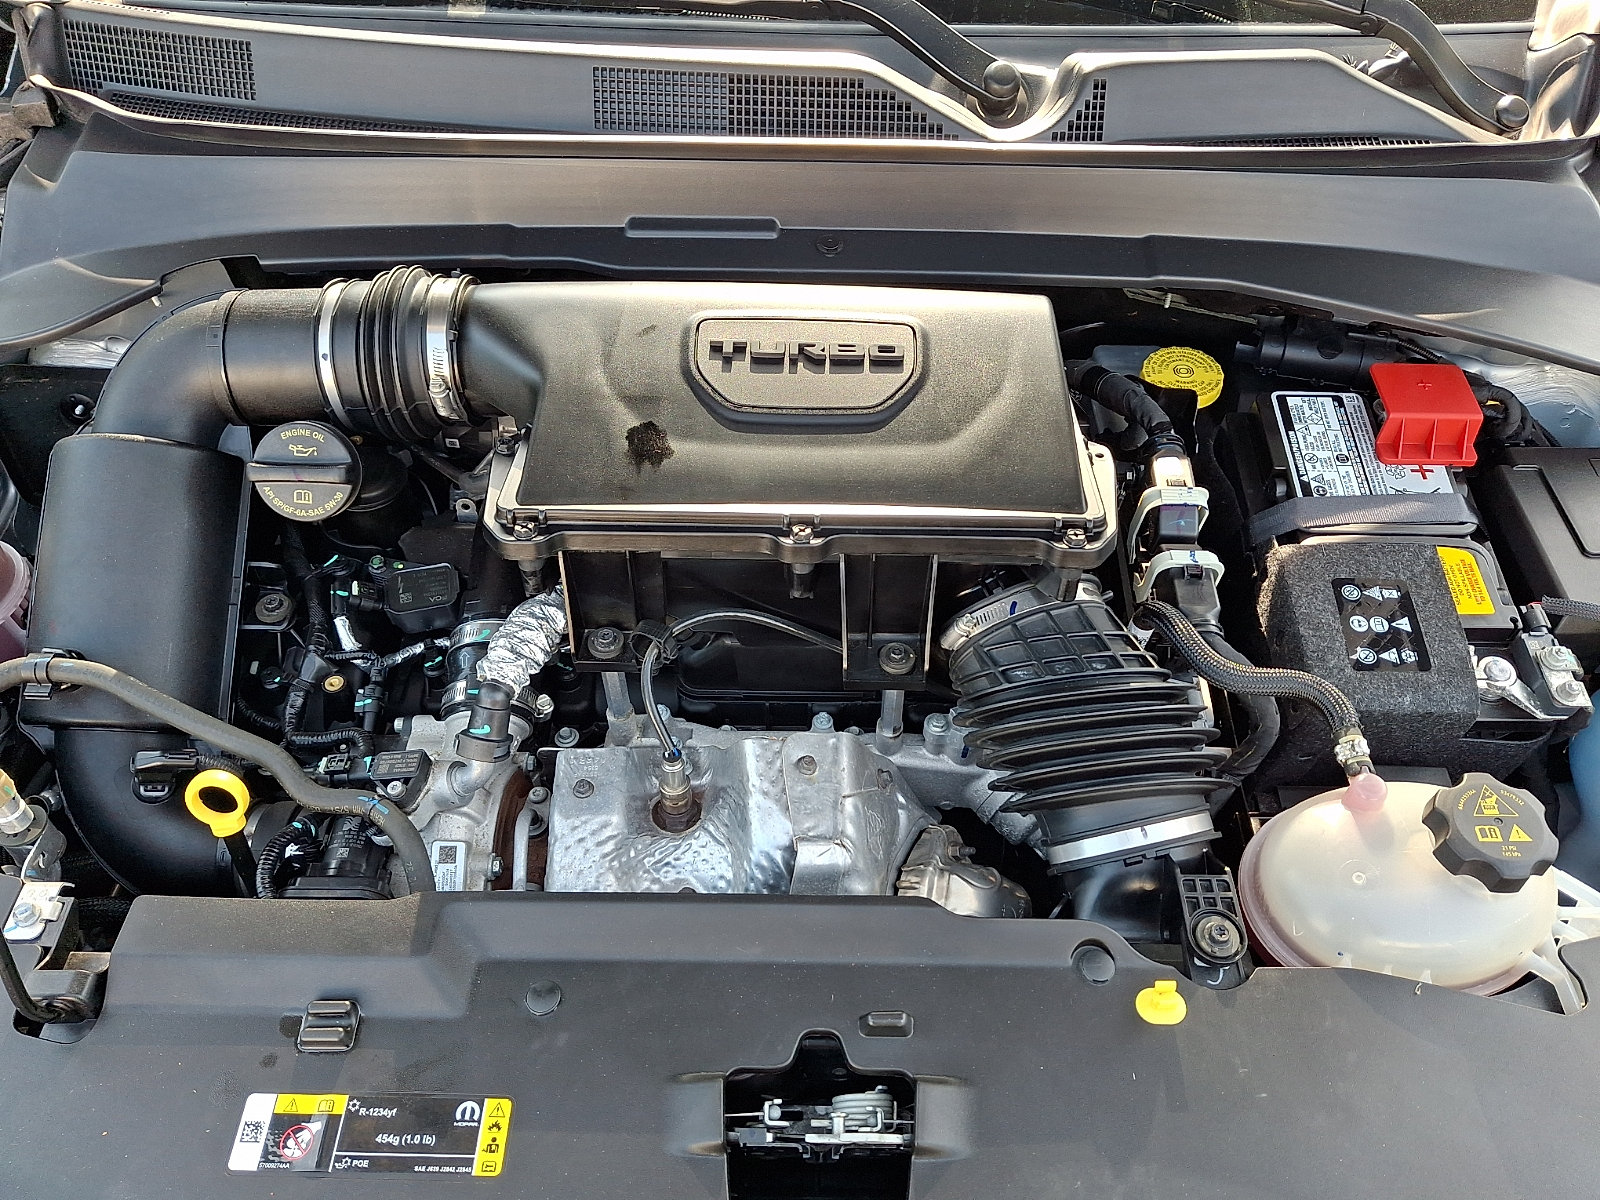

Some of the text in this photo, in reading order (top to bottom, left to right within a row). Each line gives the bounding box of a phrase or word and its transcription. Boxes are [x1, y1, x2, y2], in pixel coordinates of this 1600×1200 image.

[708, 339, 905, 367] TURBO
[280, 428, 325, 443] ENGINE OIL
[263, 486, 275, 498] API
[325, 492, 344, 510] 5W-30
[358, 1107, 398, 1118] R-1234yf
[375, 1134, 436, 1146] 454g (1.0 lb)
[352, 1160, 369, 1168] POE
